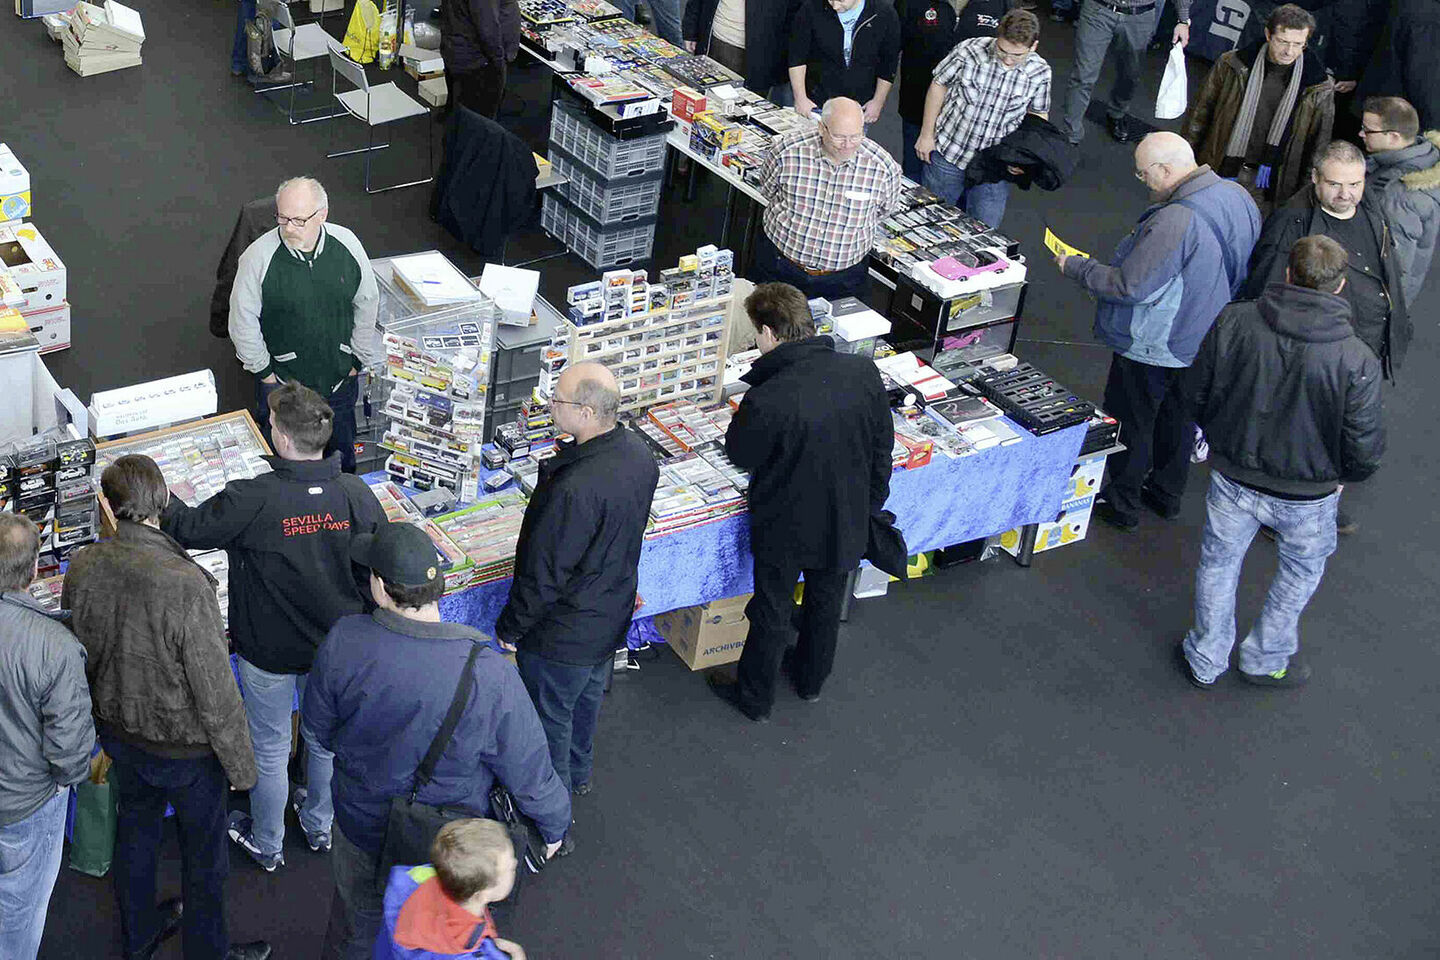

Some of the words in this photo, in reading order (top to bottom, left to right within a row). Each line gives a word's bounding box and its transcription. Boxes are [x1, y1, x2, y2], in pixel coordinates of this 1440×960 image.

[282, 512, 334, 527] SEVILLA
[283, 523, 321, 537] SPEED
[323, 520, 350, 531] DAYS
